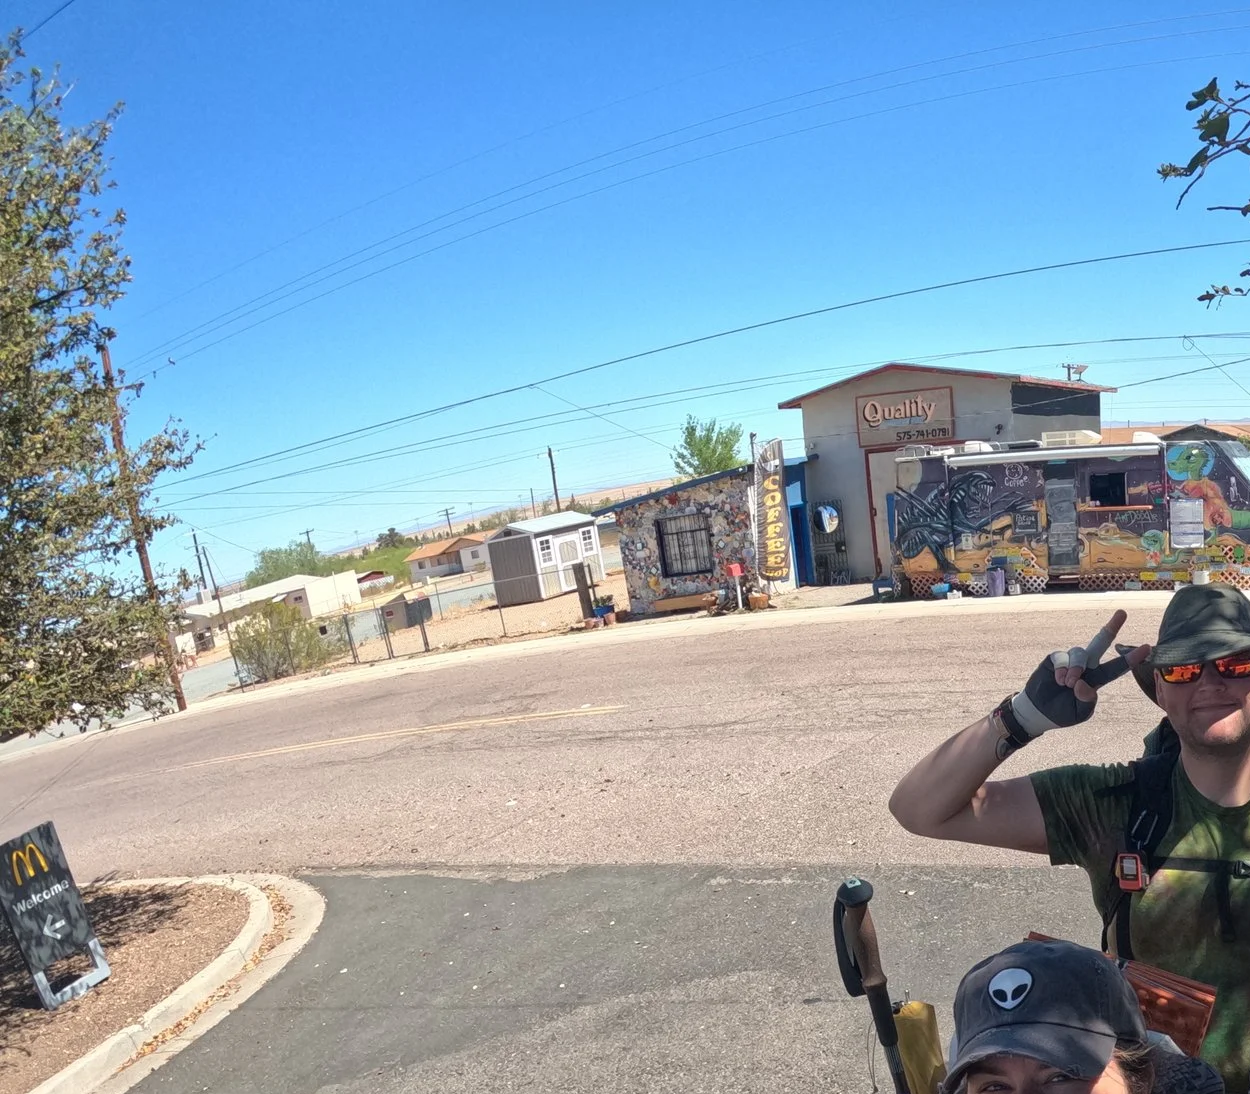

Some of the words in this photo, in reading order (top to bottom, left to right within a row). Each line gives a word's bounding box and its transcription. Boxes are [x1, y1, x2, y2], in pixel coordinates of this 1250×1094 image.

[863, 395, 936, 427] Quality
[763, 475, 785, 567] COFFEE
[12, 880, 70, 916] Welcome
